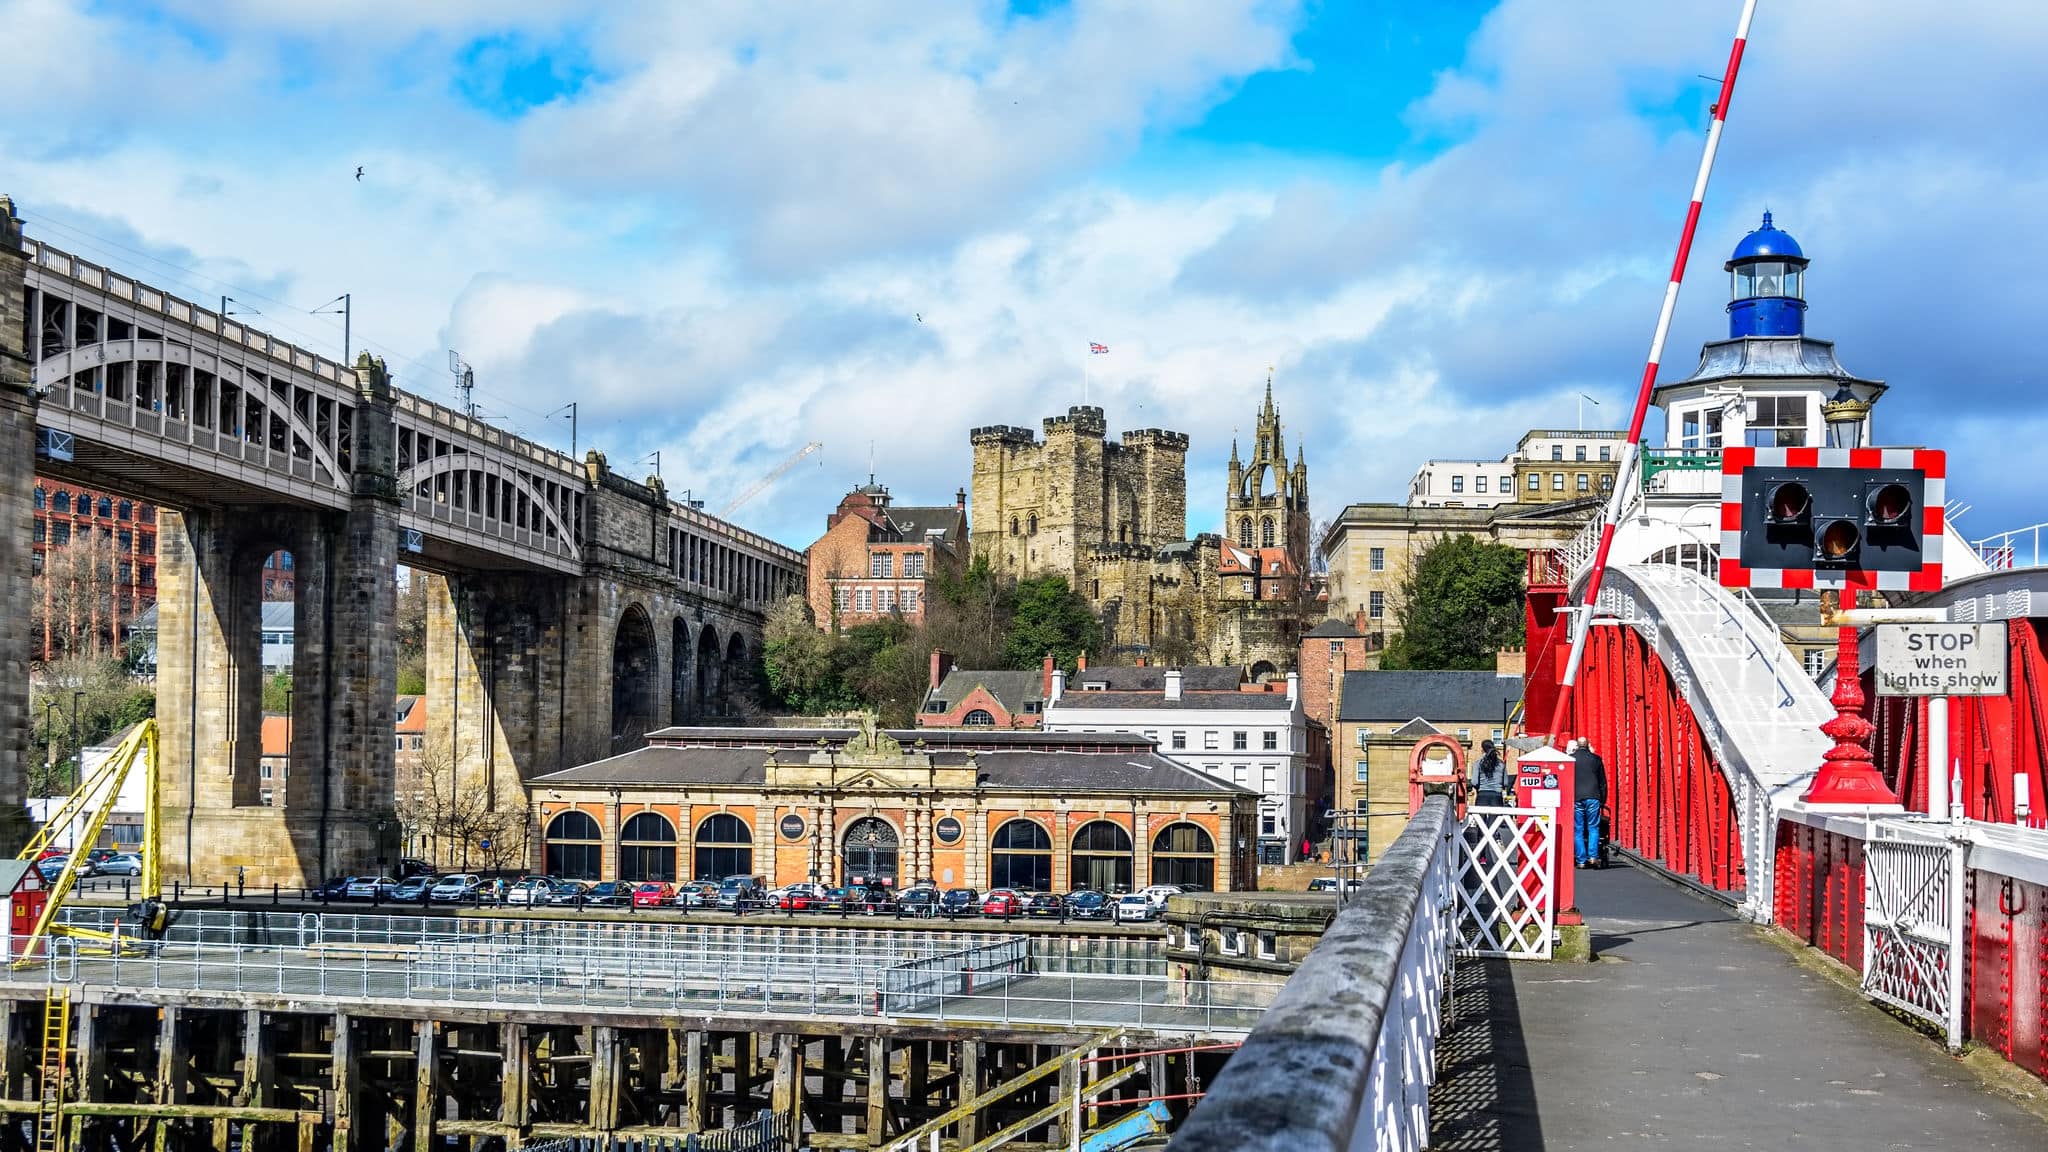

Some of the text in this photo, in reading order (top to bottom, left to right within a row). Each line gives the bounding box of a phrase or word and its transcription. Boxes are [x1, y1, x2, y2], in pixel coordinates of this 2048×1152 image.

[1908, 633, 1974, 651] STOP
[1915, 654, 1967, 669] when
[1884, 672, 1998, 690] lights show
[1522, 778, 1540, 786] 1UP
